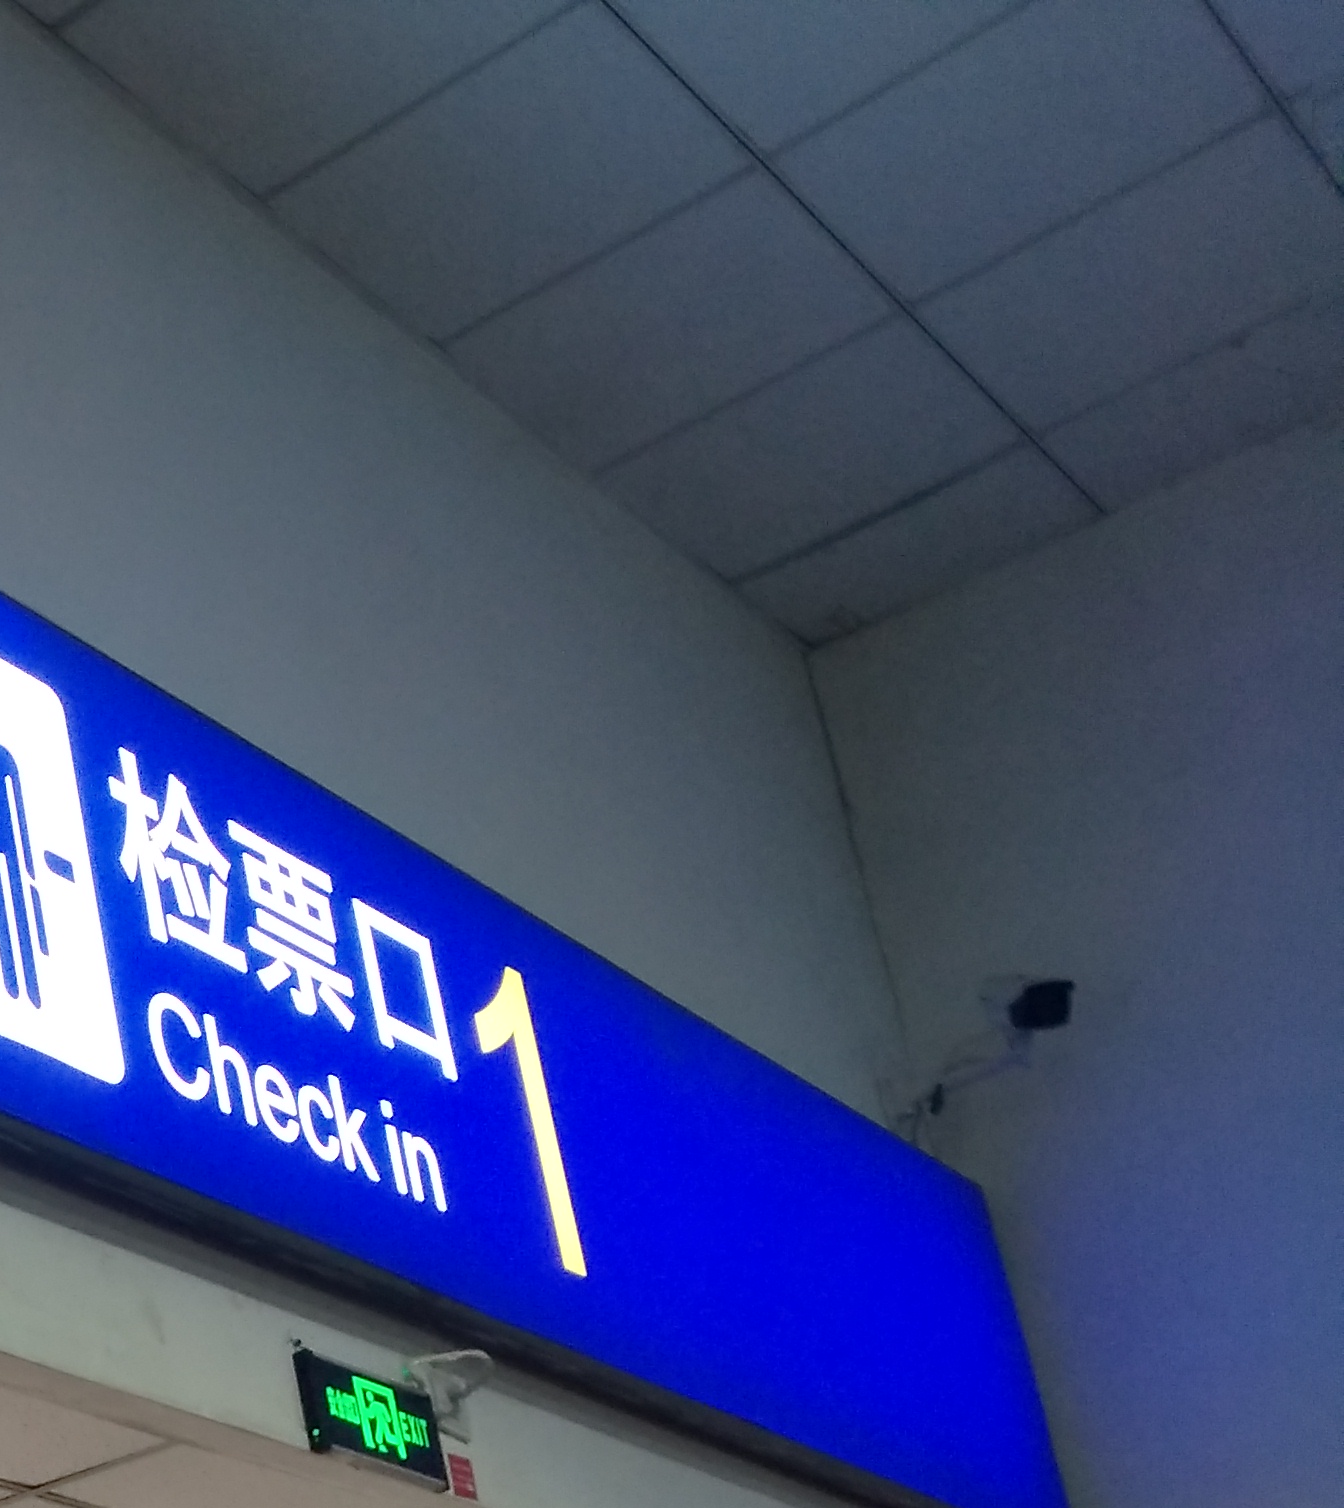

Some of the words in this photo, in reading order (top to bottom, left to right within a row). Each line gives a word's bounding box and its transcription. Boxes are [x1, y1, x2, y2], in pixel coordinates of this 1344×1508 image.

[108, 747, 458, 1081] 检票口
[146, 991, 380, 1184] Check
[380, 1099, 449, 1213] in
[473, 965, 588, 1277] 1
[398, 1411, 429, 1447] EXIT
